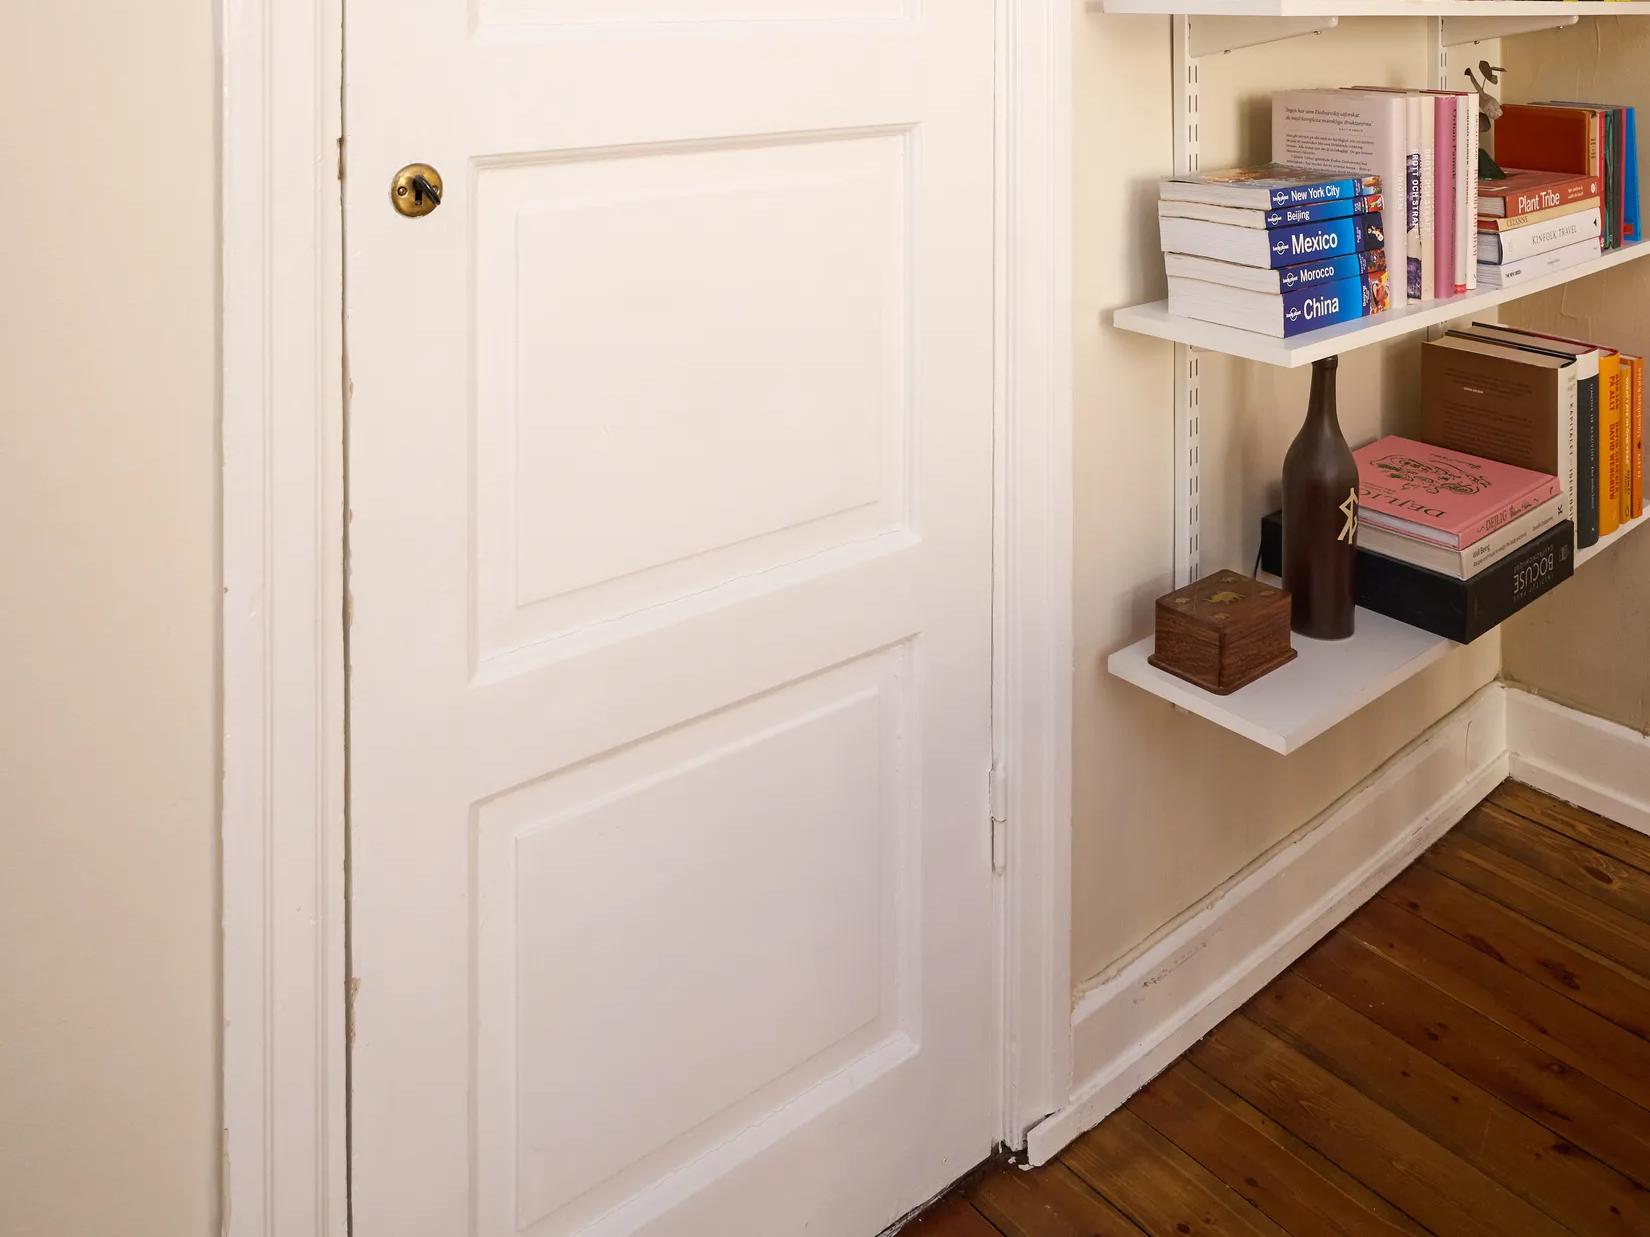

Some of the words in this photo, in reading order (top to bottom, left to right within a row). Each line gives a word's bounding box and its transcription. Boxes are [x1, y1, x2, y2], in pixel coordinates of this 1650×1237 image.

[1291, 191, 1307, 202] New
[1308, 188, 1325, 198] York
[1326, 186, 1340, 198] City
[1518, 196, 1539, 214] Plant
[1540, 190, 1560, 208] Tribe
[1287, 211, 1310, 222] Beijing
[1292, 231, 1338, 255] Mexico
[1532, 232, 1557, 245] KINFOLK
[1558, 225, 1577, 238] TRAVEL
[1300, 266, 1334, 283] Morocco
[1304, 296, 1339, 320] China
[1514, 552, 1554, 593] BOCUSE
